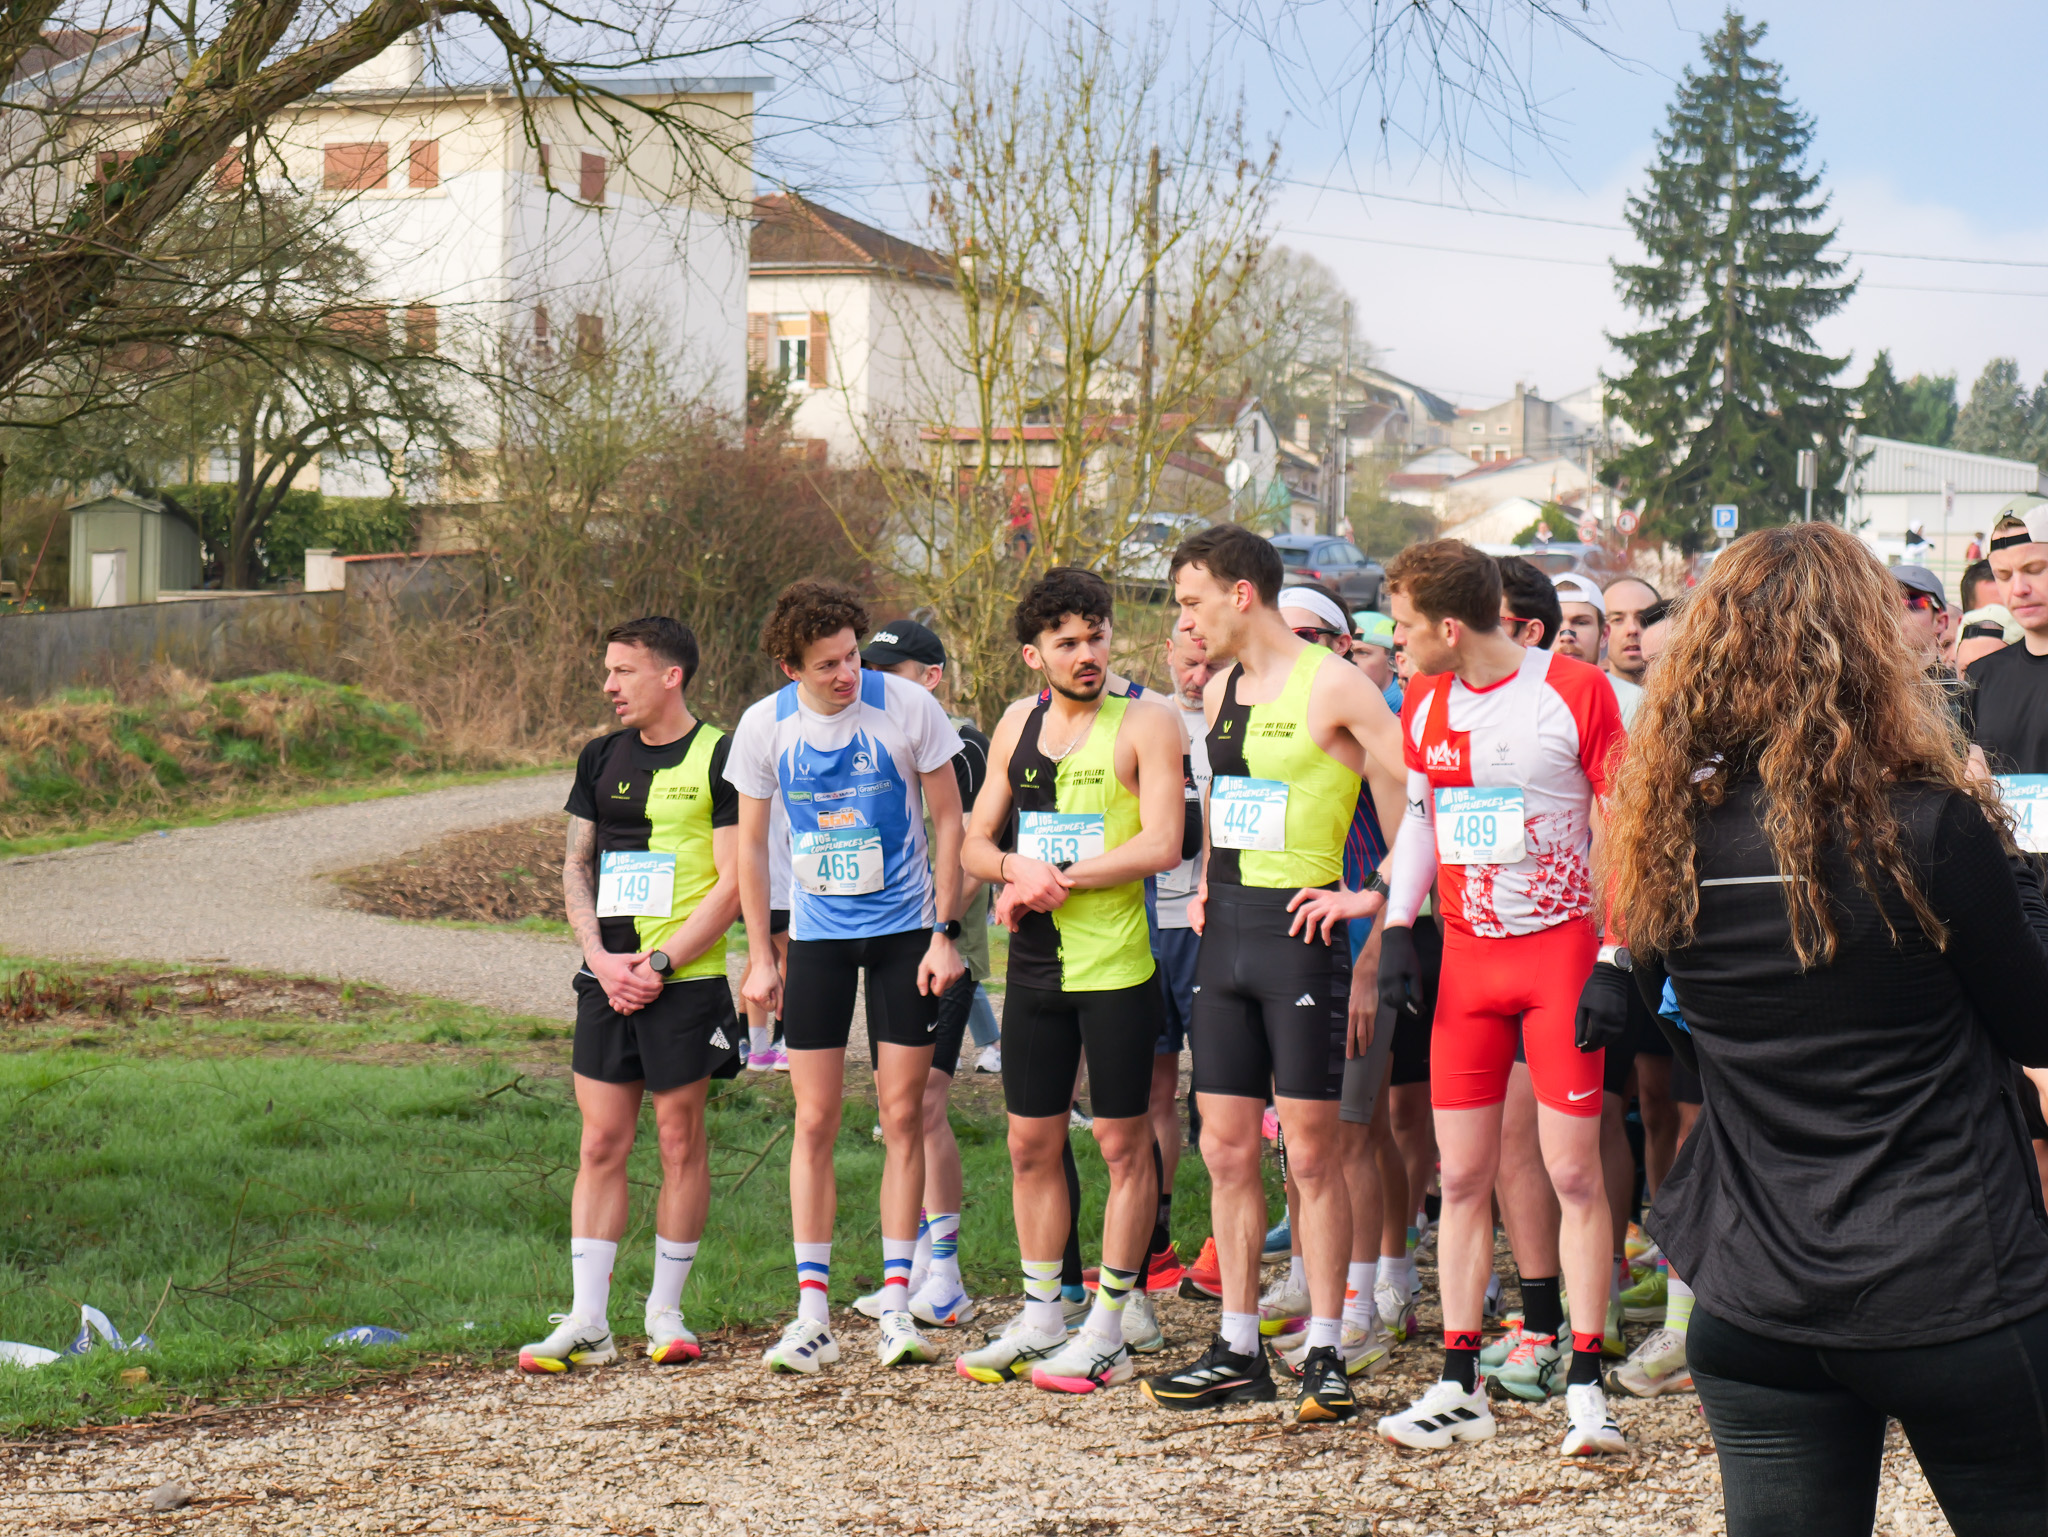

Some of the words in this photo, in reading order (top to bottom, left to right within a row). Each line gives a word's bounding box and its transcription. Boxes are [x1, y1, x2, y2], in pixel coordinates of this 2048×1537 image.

[1224, 802, 1262, 835] 442
[1450, 797, 1504, 813] CONFLUENCES
[819, 812, 855, 827] SGM
[1034, 821, 1087, 836] CONFLUENCES
[1453, 814, 1497, 847] 489
[810, 838, 864, 854] CONFLUENCES
[1037, 837, 1079, 864] 353
[817, 853, 860, 881] 465
[617, 875, 650, 902] 149
